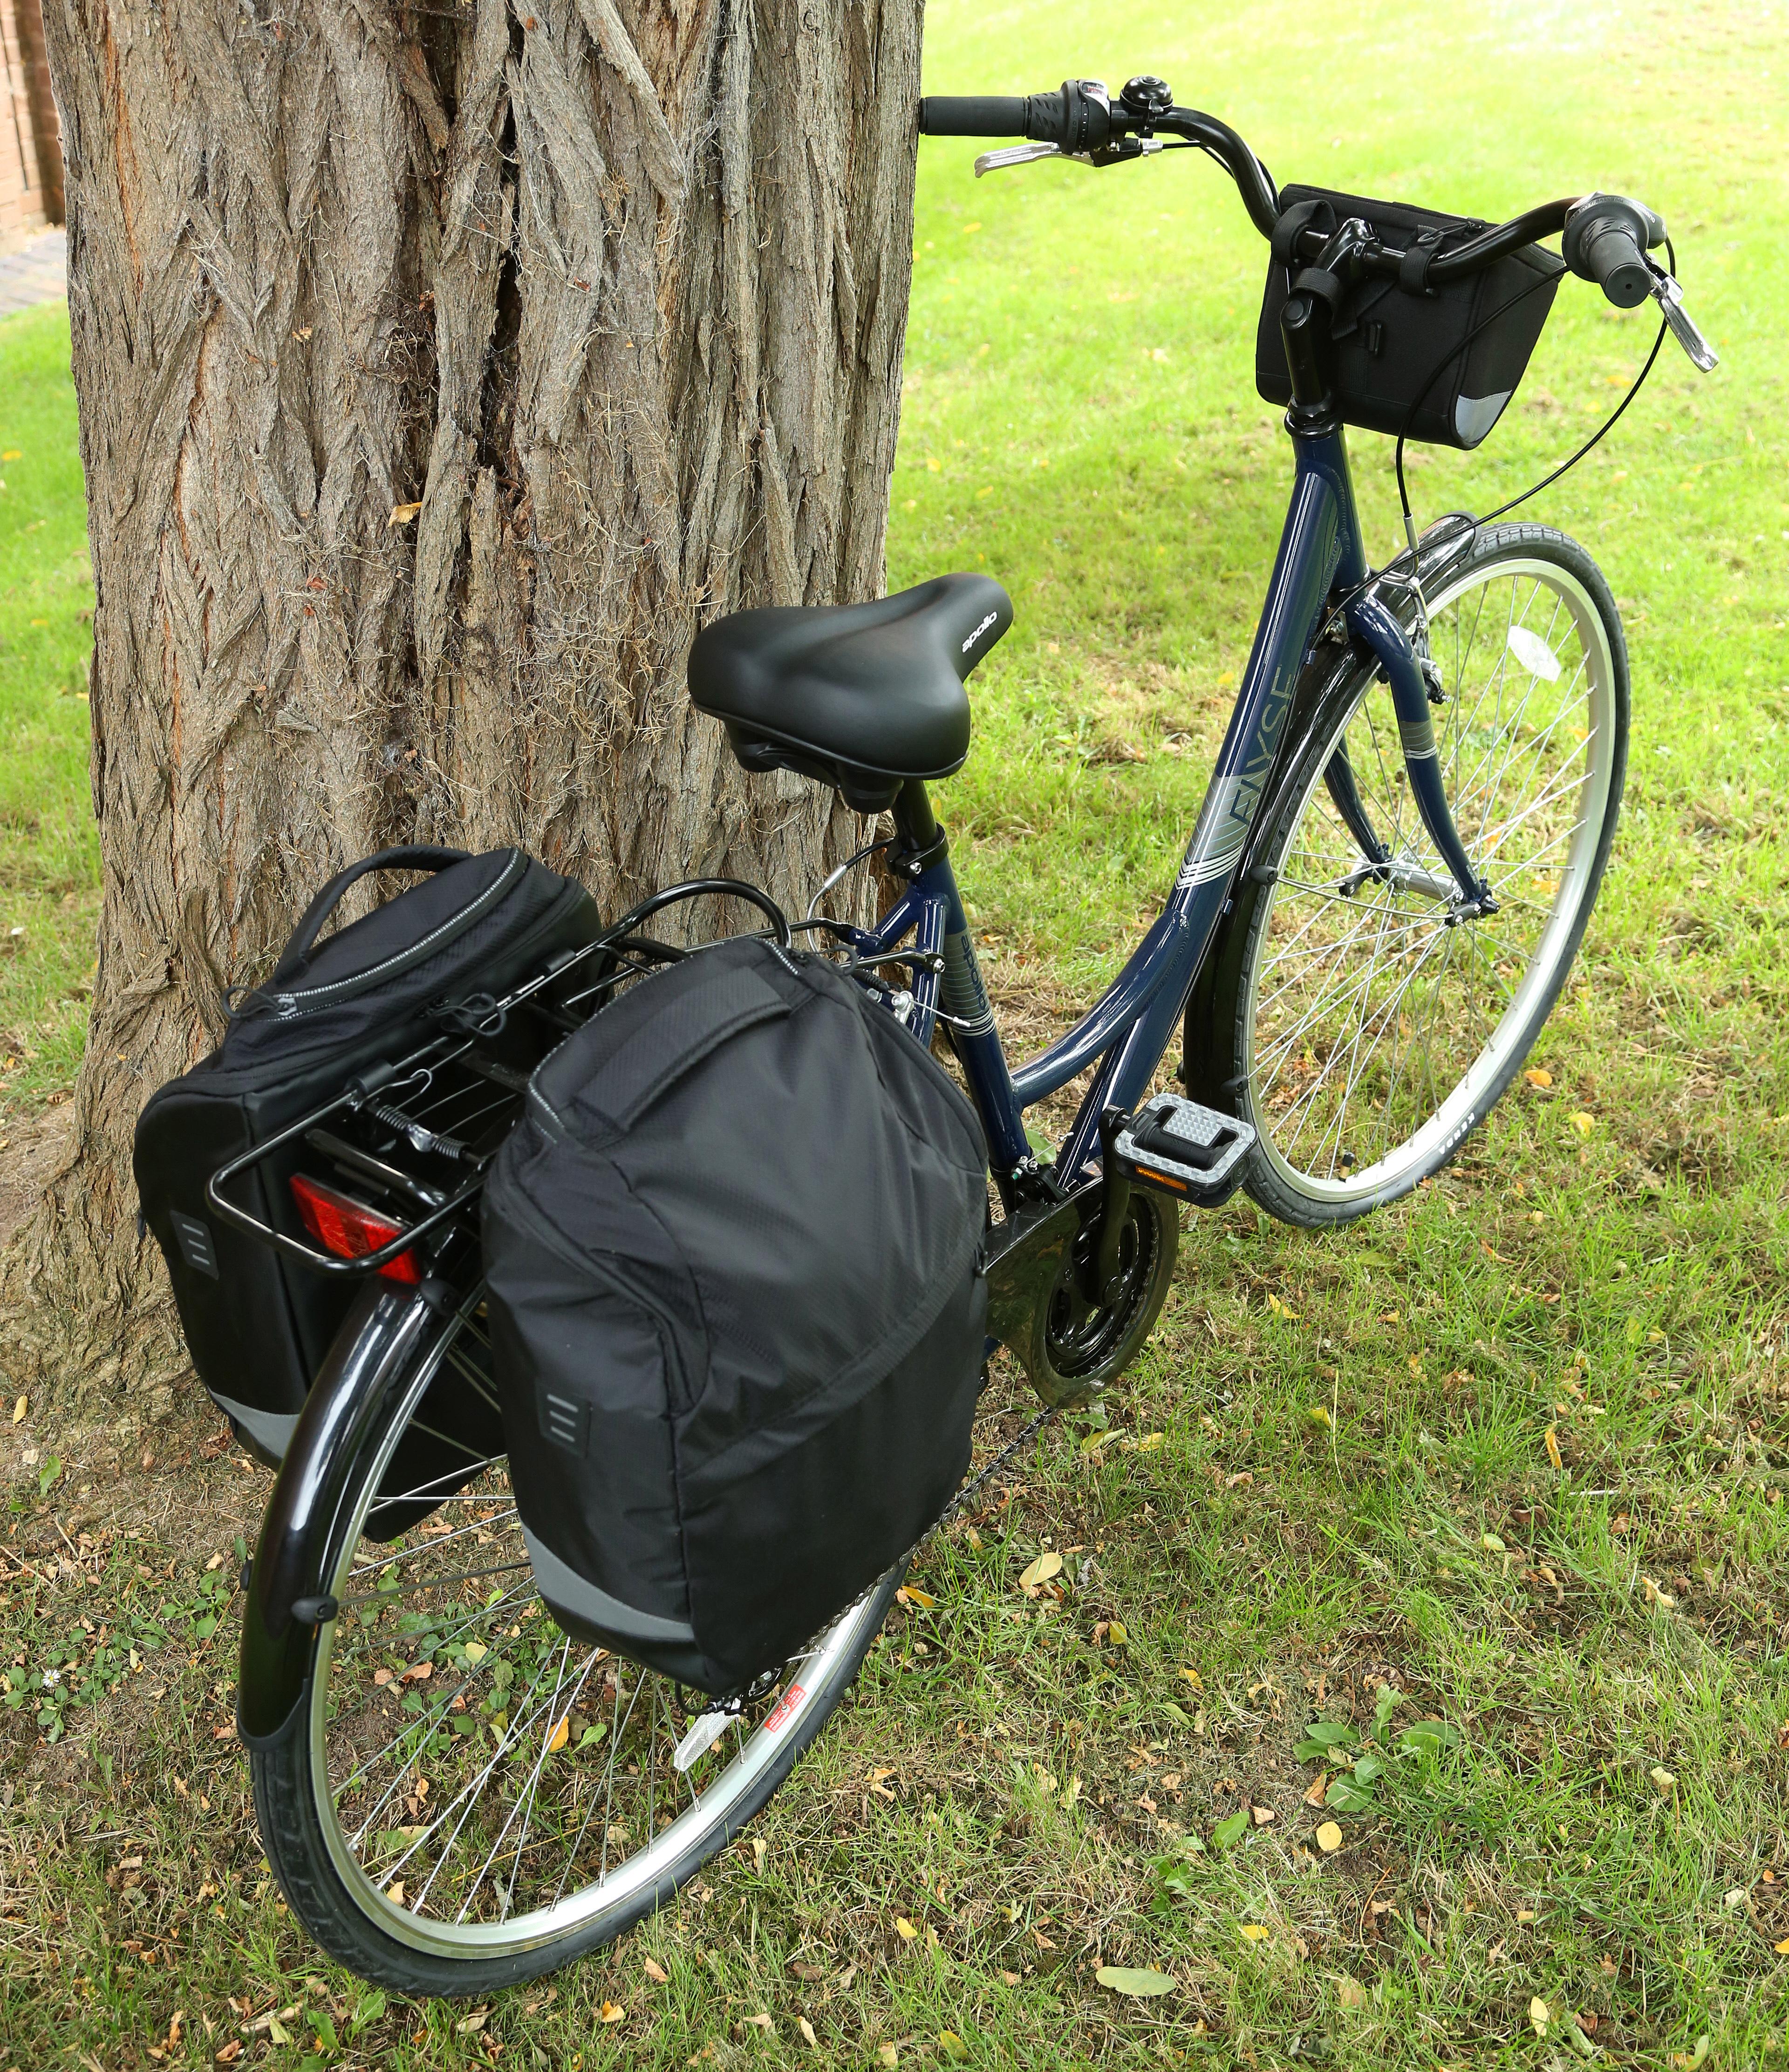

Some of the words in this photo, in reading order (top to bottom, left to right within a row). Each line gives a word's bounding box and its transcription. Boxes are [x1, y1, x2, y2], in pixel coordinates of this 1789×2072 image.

[1632, 200, 1655, 223] SHIMANO
[962, 611, 997, 653] apollo
[961, 935, 986, 1010] apollo
[1438, 1112, 1475, 1154] KENDA
